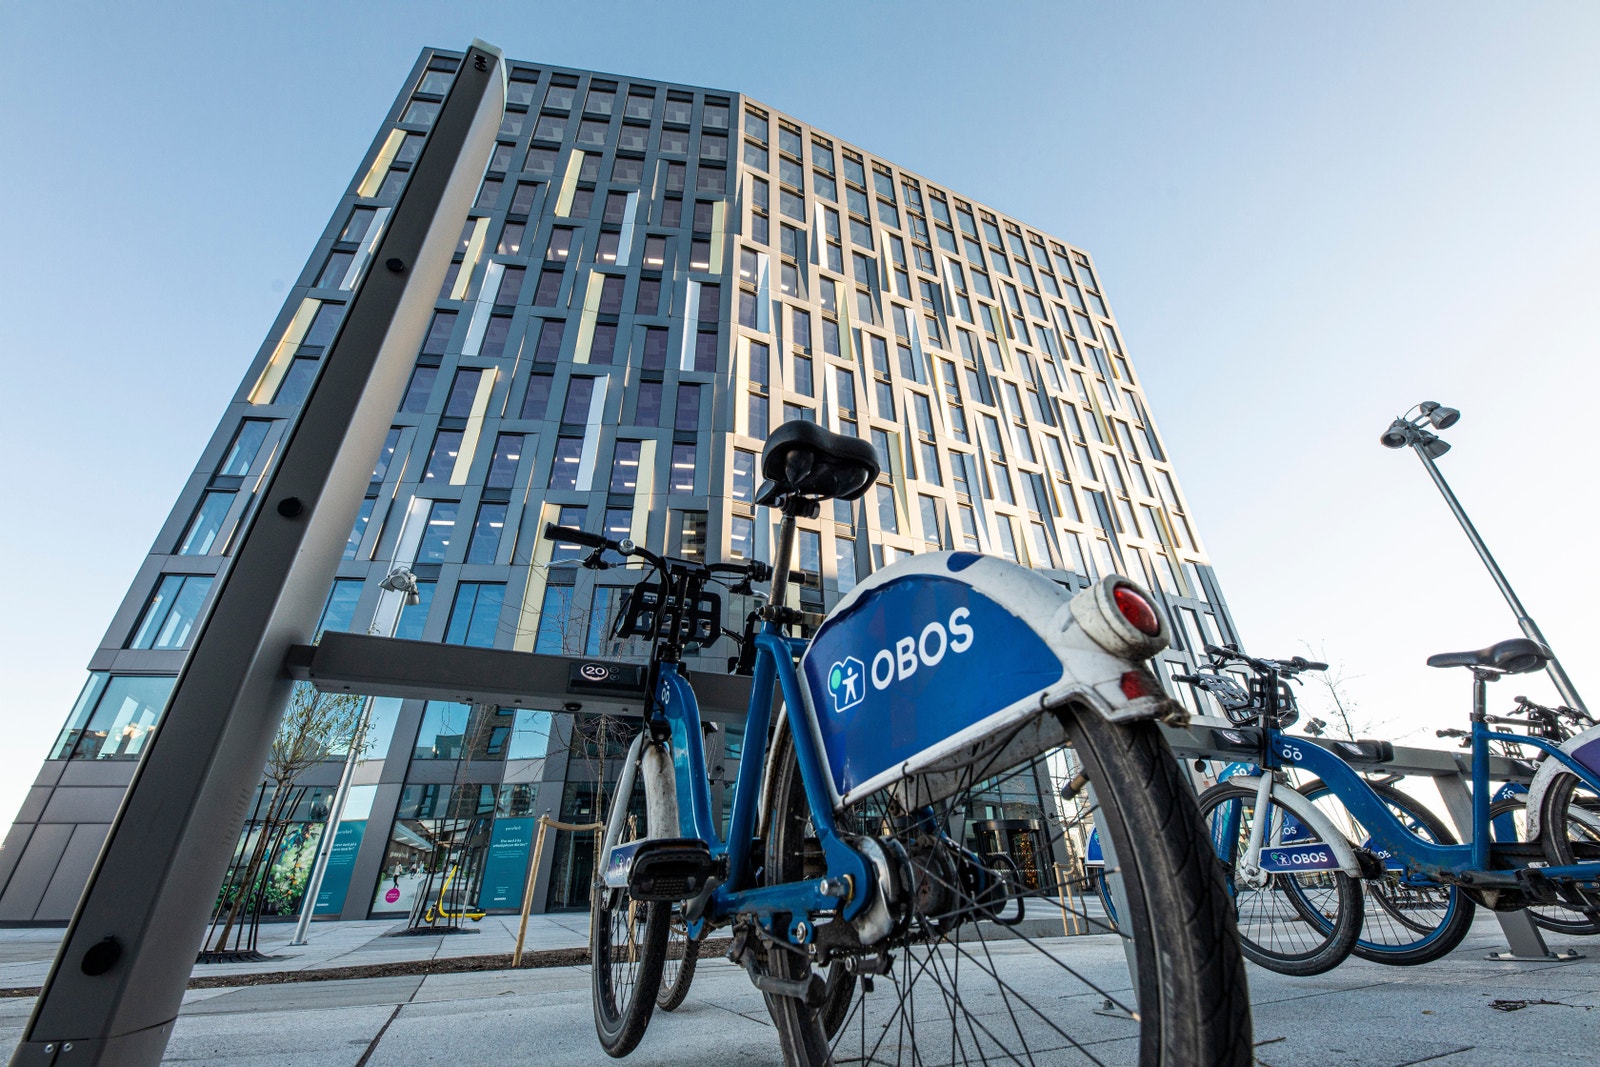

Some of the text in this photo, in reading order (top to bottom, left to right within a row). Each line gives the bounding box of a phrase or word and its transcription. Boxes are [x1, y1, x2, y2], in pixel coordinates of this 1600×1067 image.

[871, 607, 974, 690] OBOS
[586, 666, 605, 676] 20
[1281, 826, 1296, 835] OS
[1292, 852, 1328, 865] OBOS
